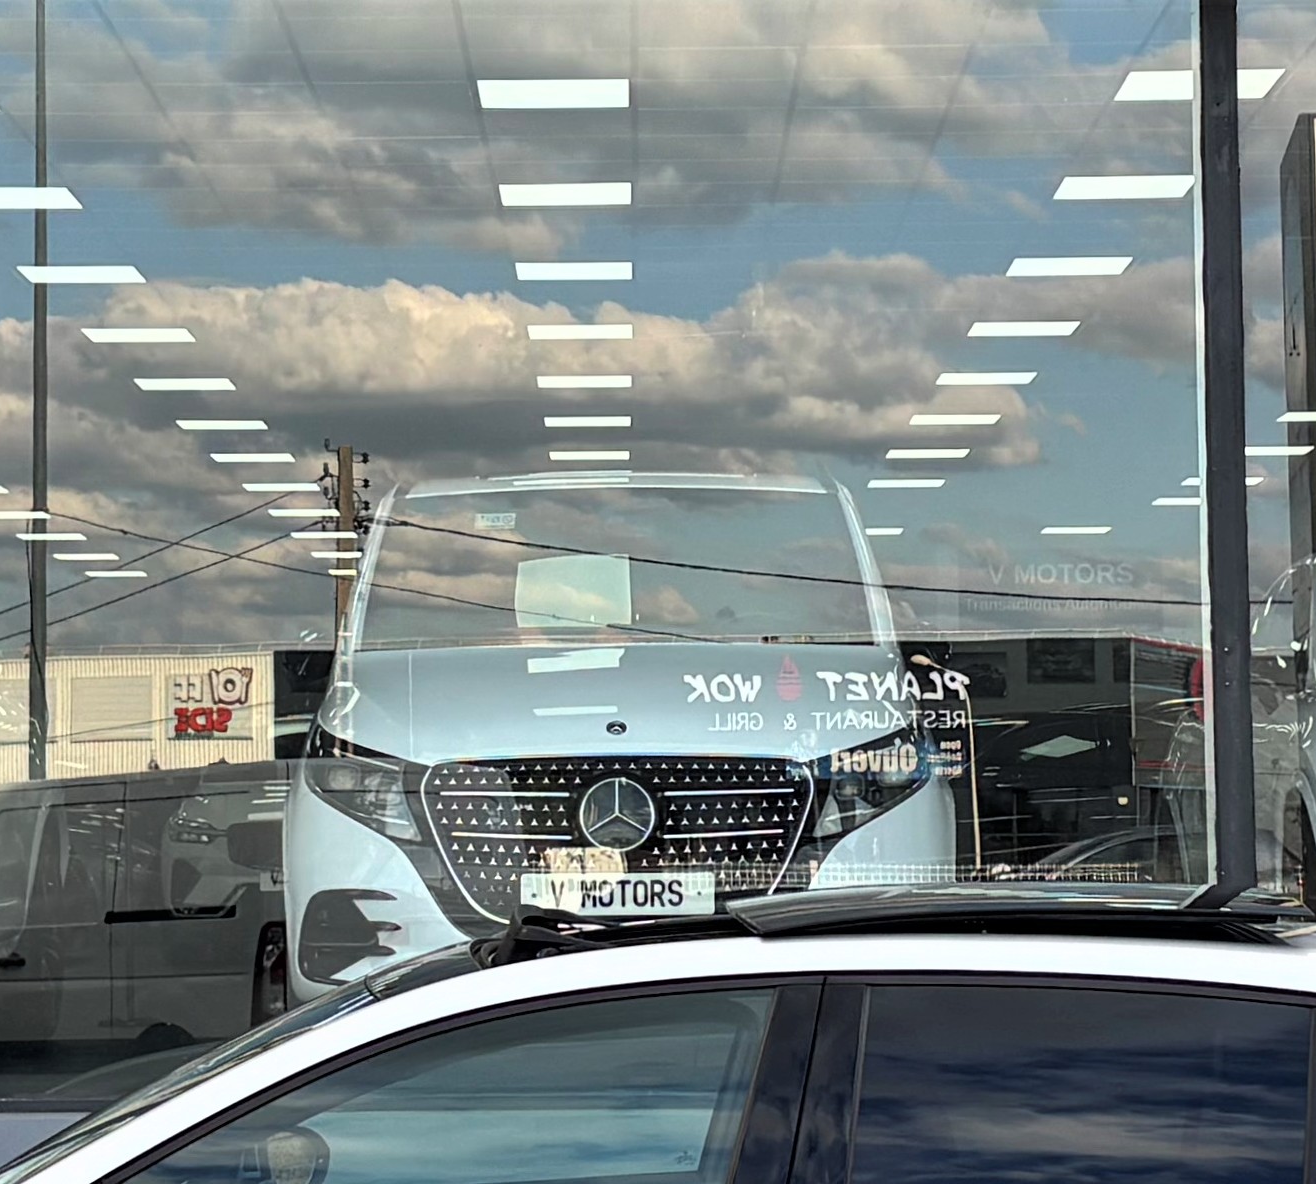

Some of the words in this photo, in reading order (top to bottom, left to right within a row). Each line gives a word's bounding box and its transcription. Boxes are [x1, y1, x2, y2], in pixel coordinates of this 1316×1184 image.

[988, 564, 1005, 585] V
[1014, 563, 1134, 585] MOTORS
[550, 881, 565, 907] V
[581, 879, 684, 908] MOTORS
